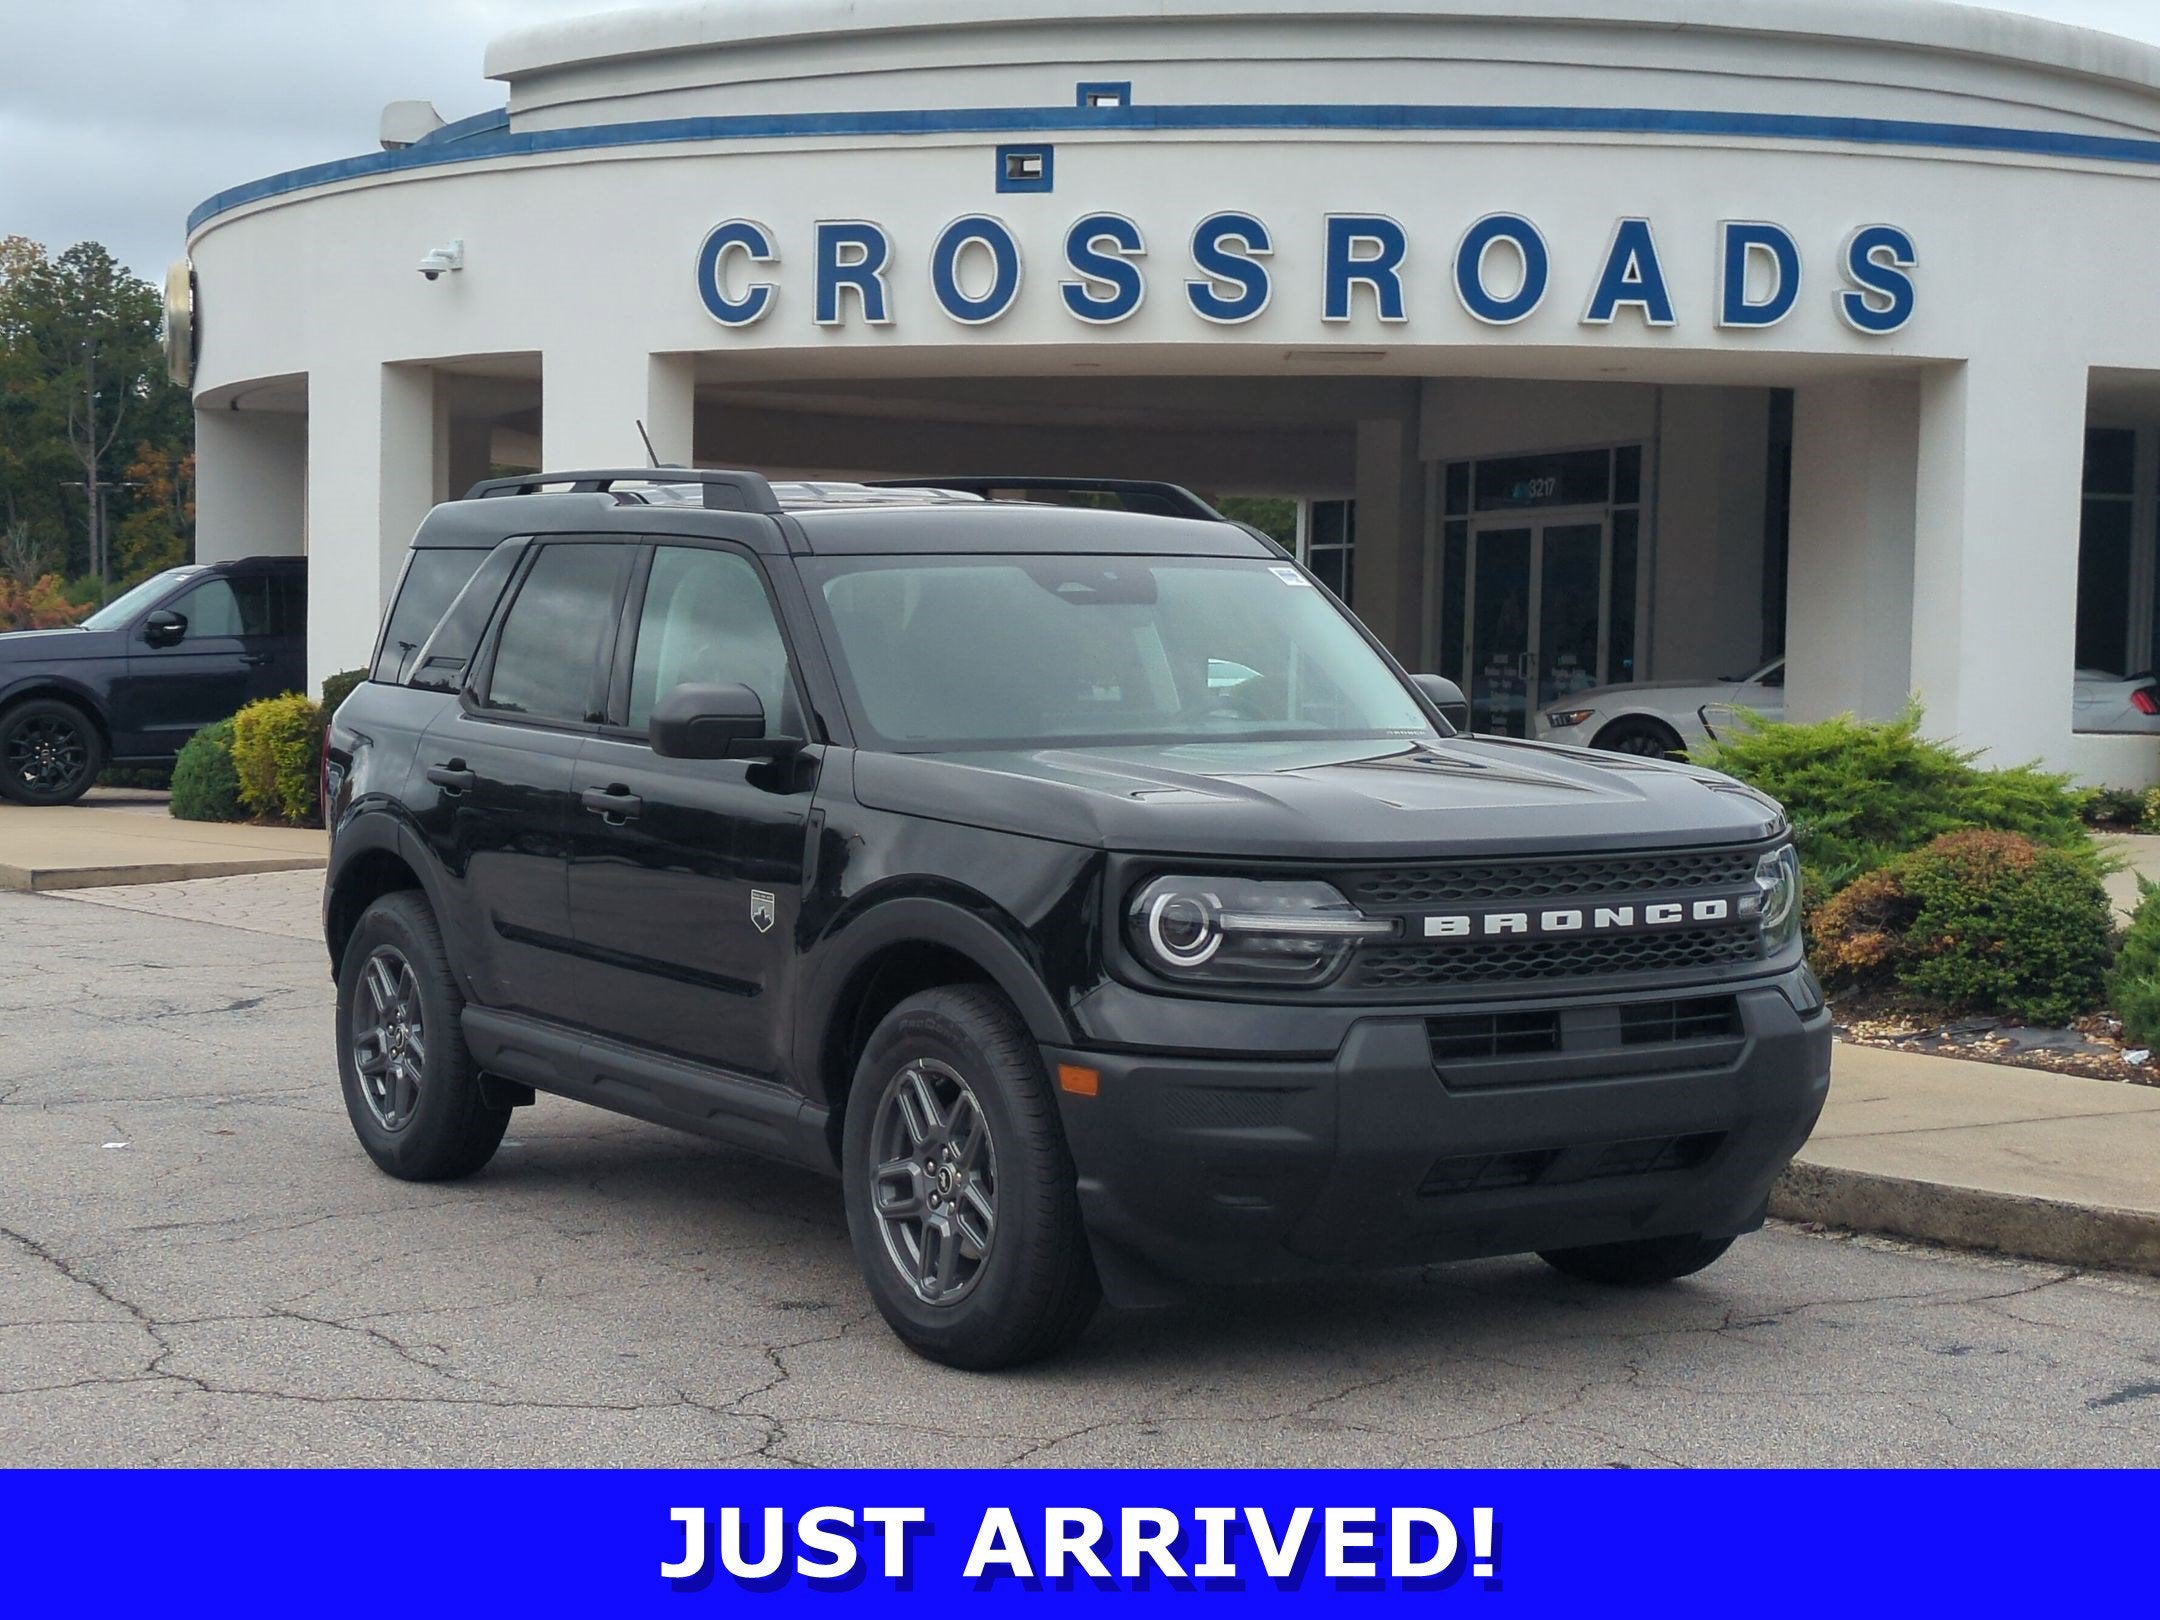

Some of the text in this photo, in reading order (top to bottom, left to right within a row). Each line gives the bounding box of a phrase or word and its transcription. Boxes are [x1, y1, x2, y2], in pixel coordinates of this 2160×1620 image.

[696, 210, 1919, 336] CROSSROADS
[1528, 477, 1556, 497] 3217
[1423, 899, 1728, 937] BRONCO
